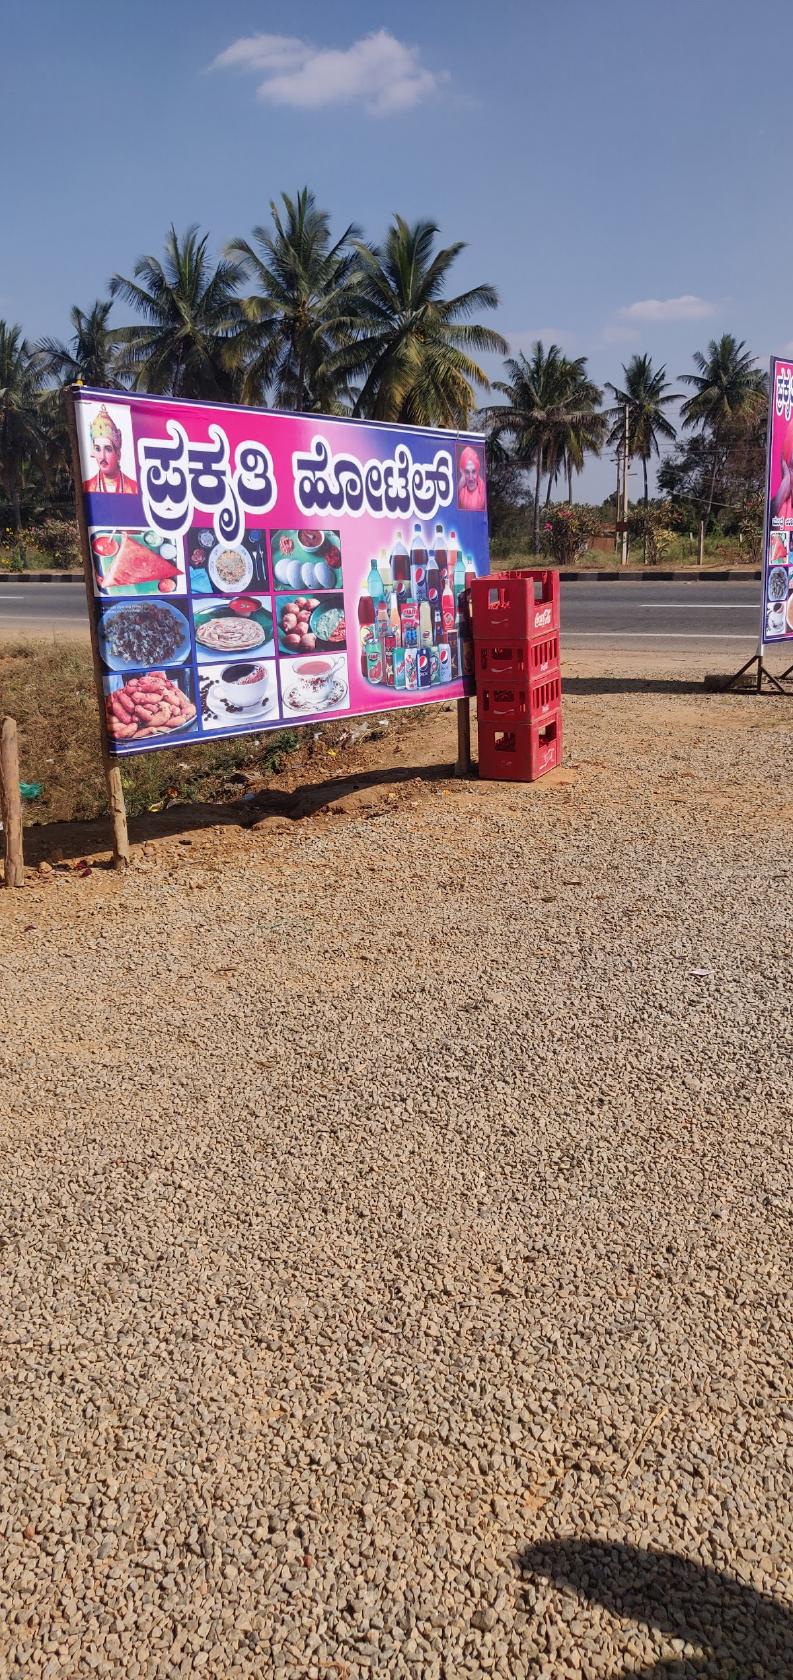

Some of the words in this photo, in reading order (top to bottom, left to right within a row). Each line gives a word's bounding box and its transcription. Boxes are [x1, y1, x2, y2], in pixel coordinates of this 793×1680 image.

[777, 368, 793, 421] ಪ್ರಕೃ
[139, 421, 276, 546] ಪ್ರಕೃತಿ
[294, 437, 453, 518] ಹೋಟೆಲ್
